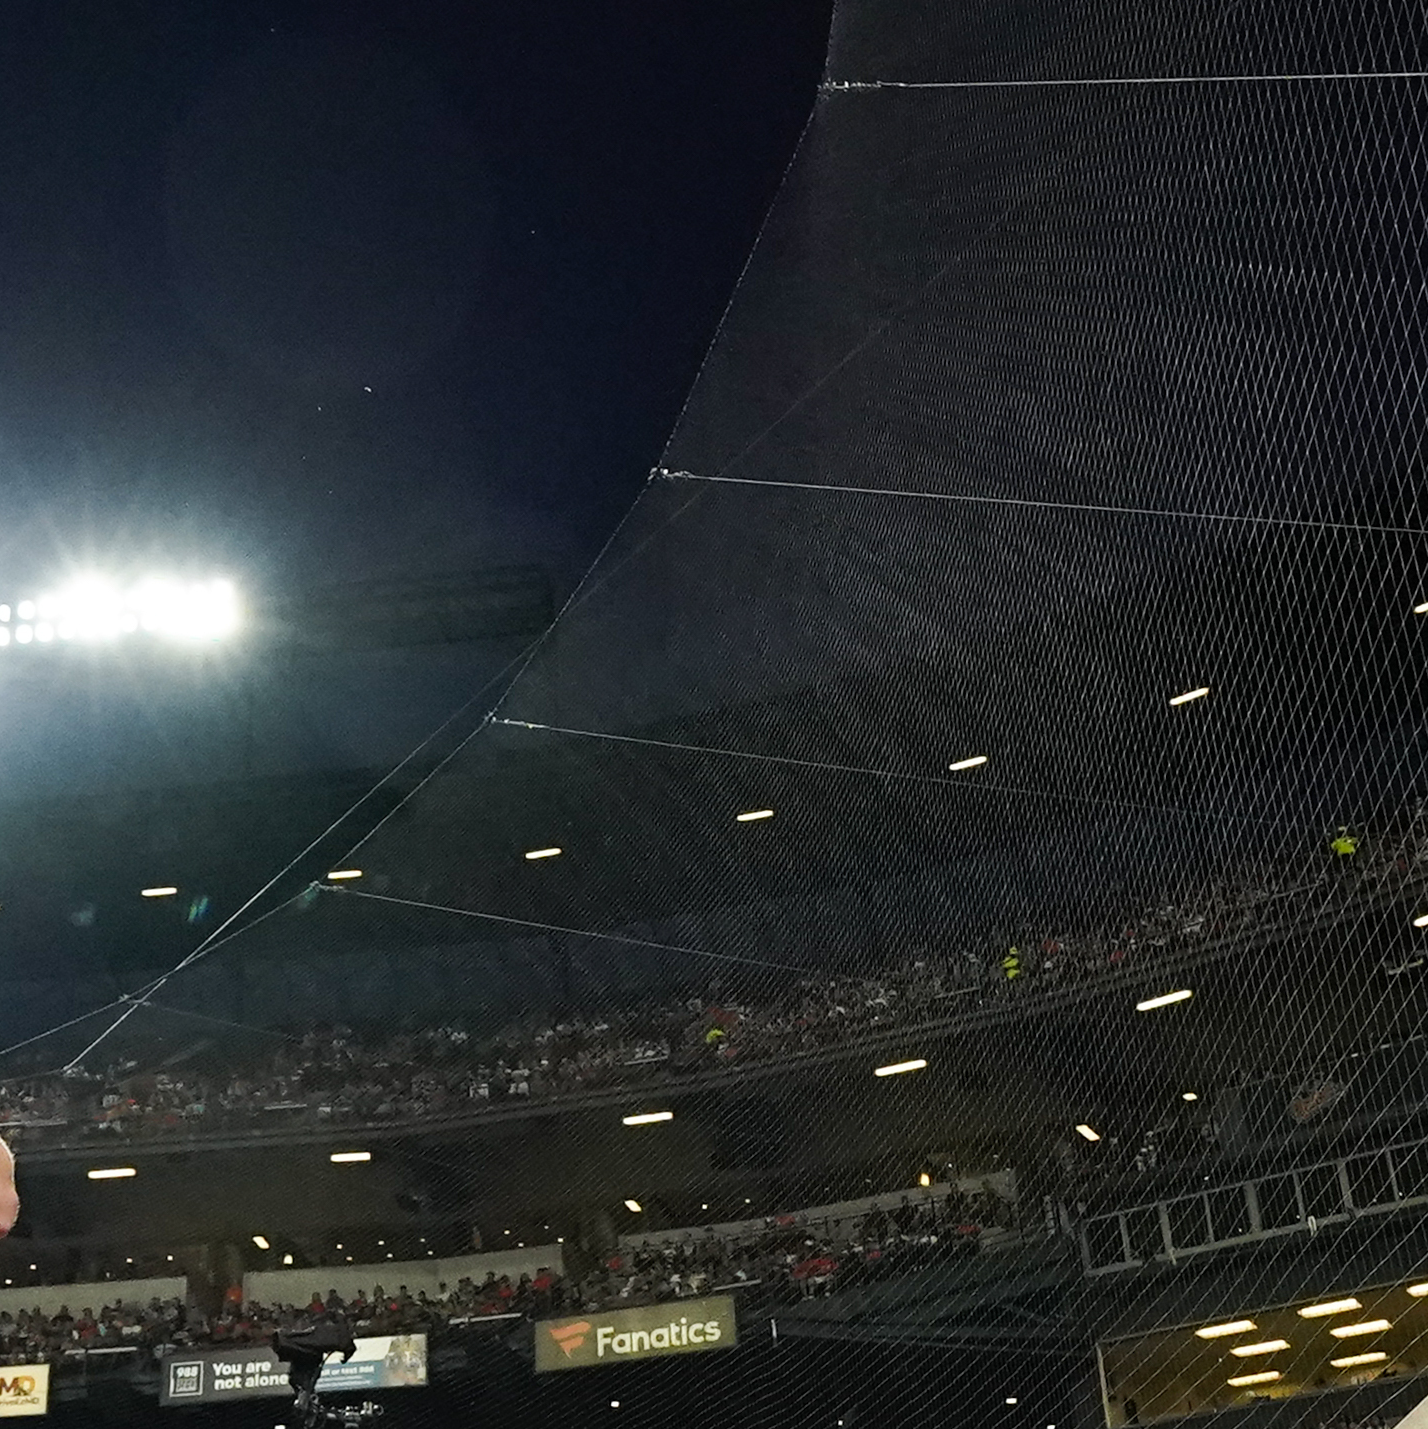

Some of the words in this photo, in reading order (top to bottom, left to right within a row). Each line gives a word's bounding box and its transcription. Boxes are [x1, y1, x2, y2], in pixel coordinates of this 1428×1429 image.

[597, 1317, 721, 1357] Fanatics
[213, 1363, 241, 1376] You
[246, 1361, 271, 1373] are
[214, 1376, 241, 1390] not
[245, 1372, 289, 1387] alone
